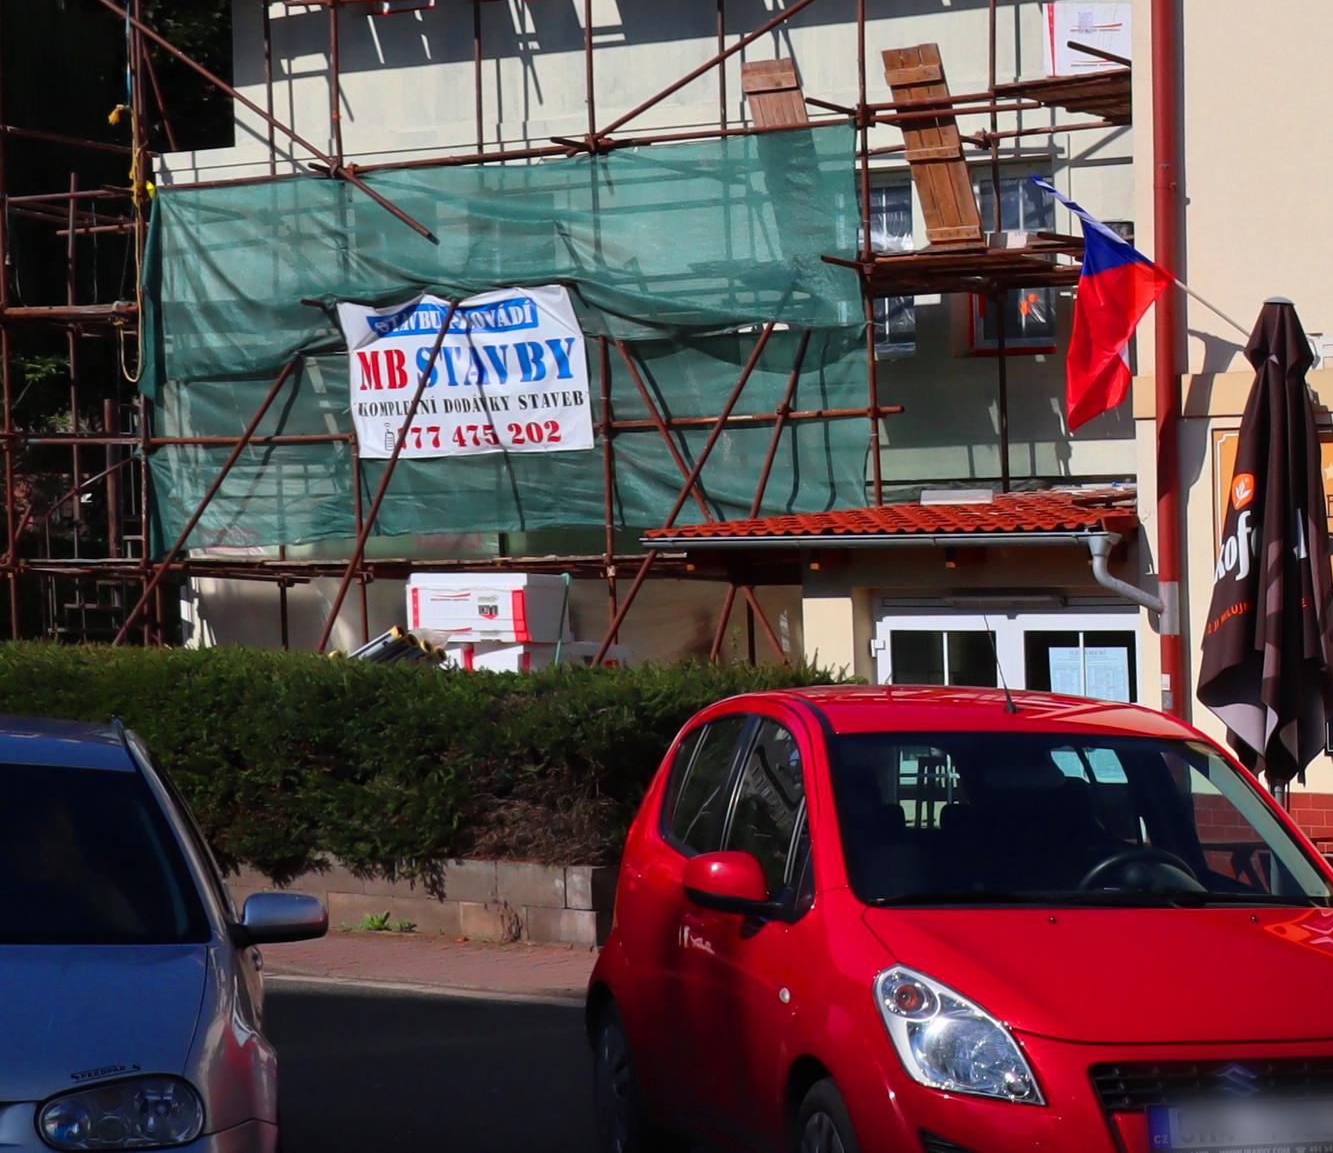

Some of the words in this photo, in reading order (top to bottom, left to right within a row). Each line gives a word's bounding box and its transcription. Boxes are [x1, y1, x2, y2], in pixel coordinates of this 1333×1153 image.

[357, 349, 408, 390] MB
[415, 337, 576, 388] STAVBY
[519, 390, 584, 411] STAVEB
[453, 424, 499, 447] 475
[508, 421, 562, 445] 202
[1153, 1135, 1169, 1145] CZ
